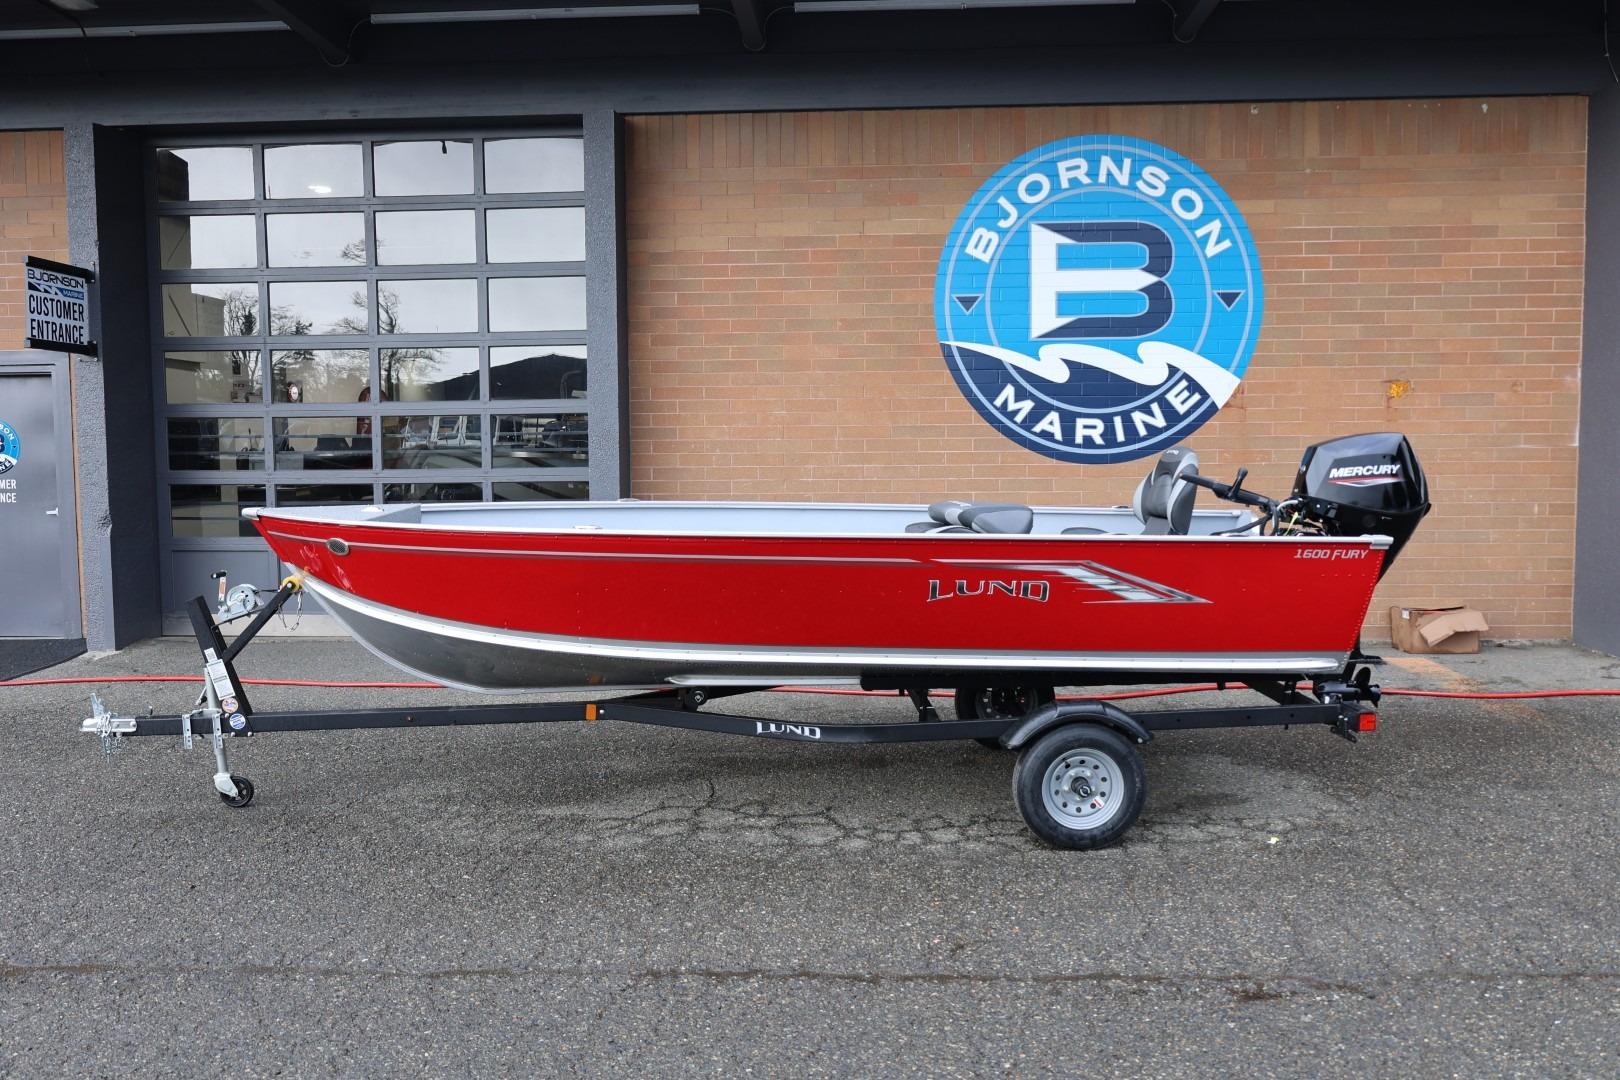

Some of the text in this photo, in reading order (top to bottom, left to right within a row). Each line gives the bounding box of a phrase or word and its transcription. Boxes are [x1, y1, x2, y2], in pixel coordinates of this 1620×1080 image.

[965, 155, 1232, 263] BJORNSON
[27, 268, 84, 289] BJORNSON
[29, 294, 84, 322] CUSTOMER
[30, 318, 84, 344] ENTRANCE
[993, 379, 1201, 445] MARINE
[1329, 464, 1400, 478] MERCURY
[1293, 549, 1369, 561] 1600 FURY
[926, 579, 1050, 602] LUND
[755, 721, 821, 740] LUND
